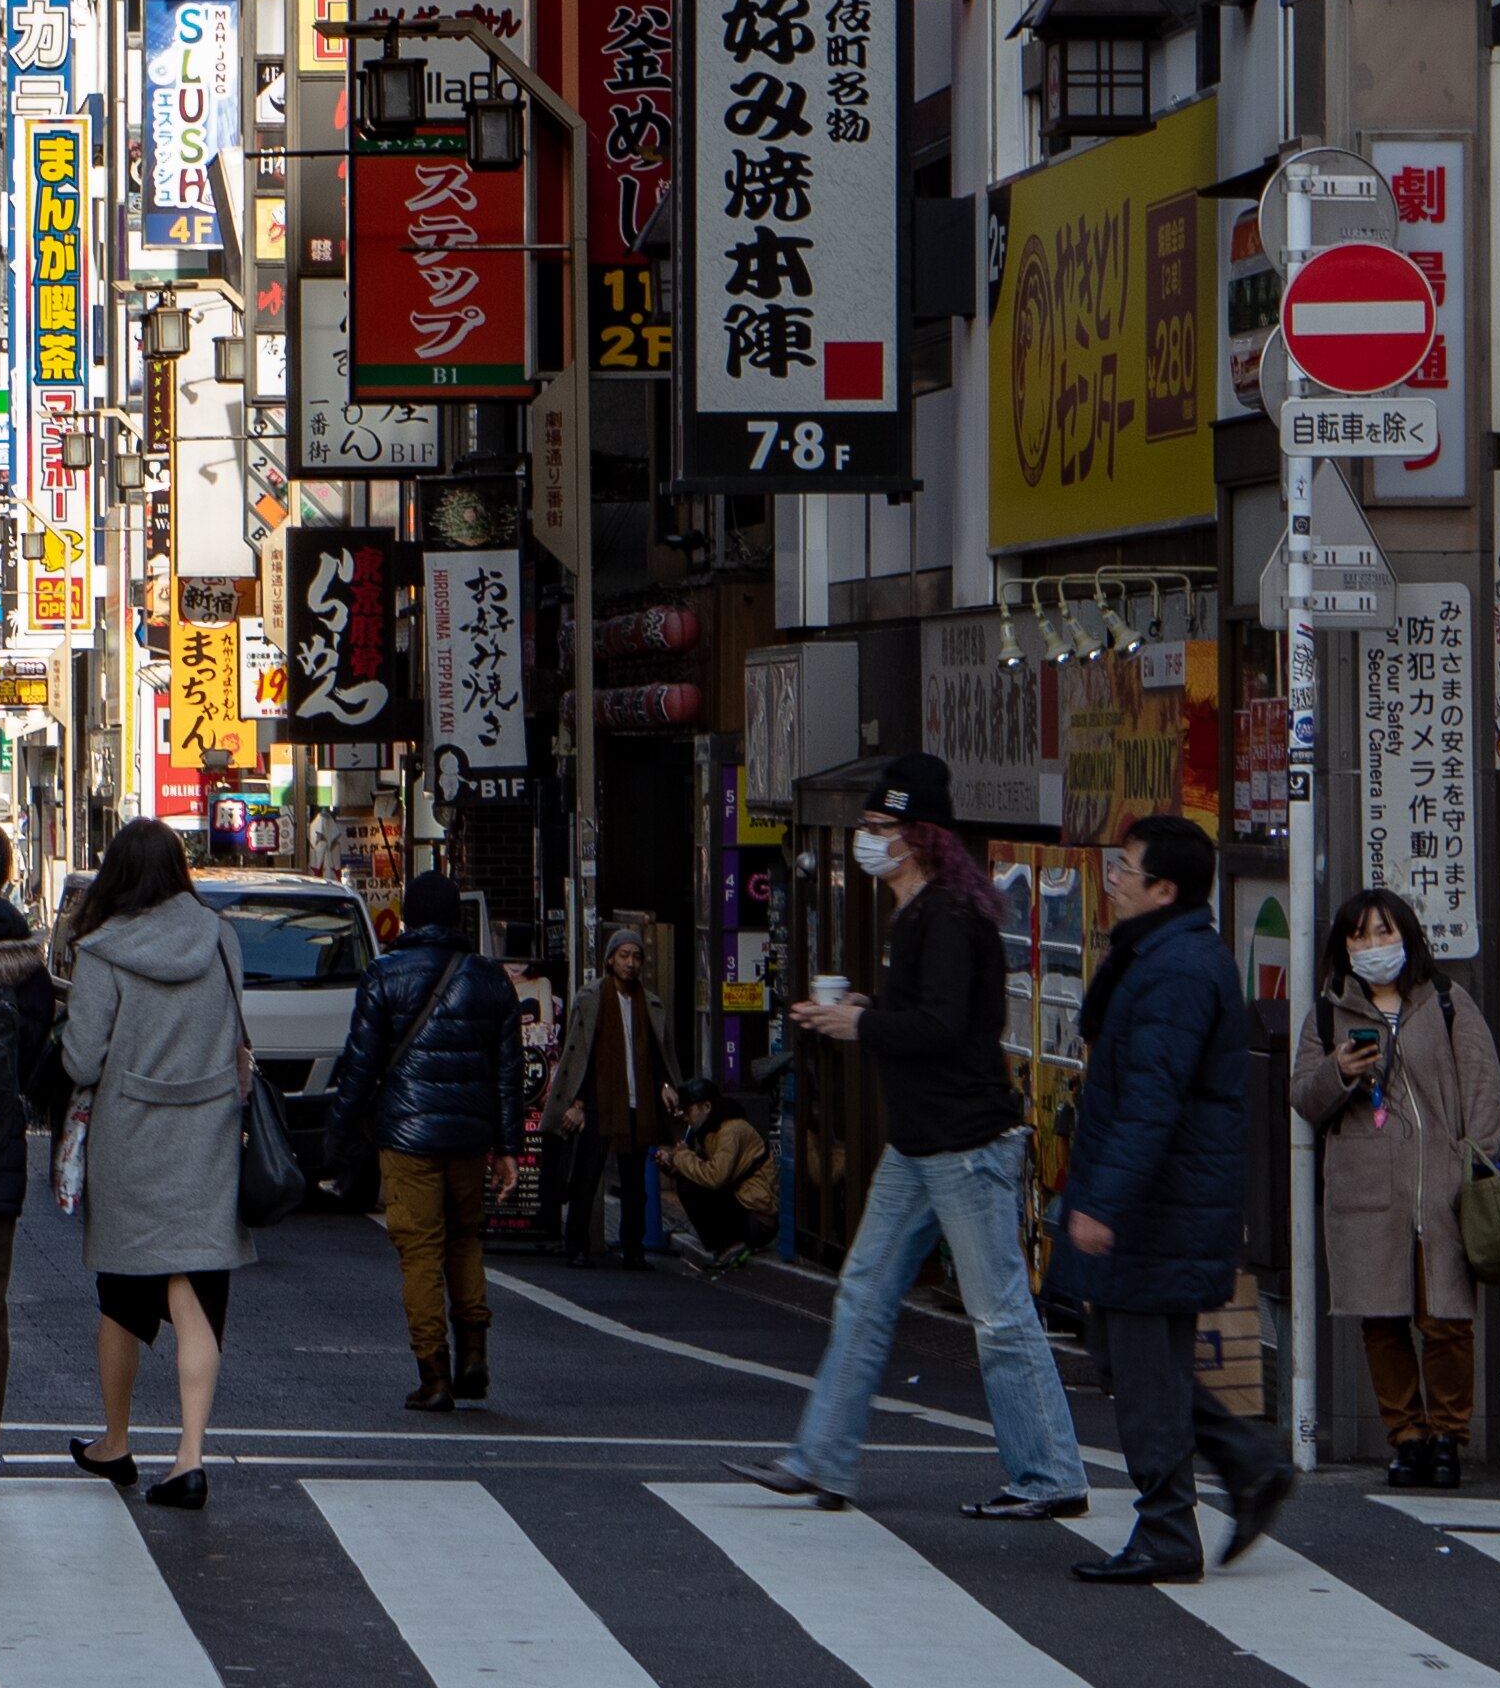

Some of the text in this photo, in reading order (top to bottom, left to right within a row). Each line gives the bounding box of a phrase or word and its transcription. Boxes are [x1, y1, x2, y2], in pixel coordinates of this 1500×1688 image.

[158, 93, 174, 202] エスラッシュ
[39, 137, 77, 380] まんが喫茶
[168, 216, 213, 244] 4F
[404, 164, 486, 359] ステップ
[988, 213, 1006, 283] 2F
[1054, 197, 1131, 353] やきとり
[432, 367, 460, 384] B1
[1148, 311, 1194, 400] ¥280
[307, 398, 331, 464] 一番街
[390, 443, 435, 464] B1F
[544, 411, 563, 528] 劇場通り一番街
[1056, 352, 1136, 487] センター
[1293, 411, 1425, 445] 自転車を除く
[38, 603, 80, 617] OPEN
[271, 549, 285, 629] 劇場通り一番街
[351, 547, 384, 679] 東京豚骨
[432, 569, 448, 641] HIROSHIMA
[182, 631, 219, 752] まっちゃん
[460, 566, 519, 747] お好み焼き
[1387, 651, 1403, 756] Your Safety
[1367, 648, 1386, 820] Security Camera in
[1407, 617, 1440, 896] 防犯カメラ作動中
[1439, 600, 1467, 911] みなさまの安全を守ります
[161, 784, 201, 797] ONLINE
[480, 778, 526, 799] B1F
